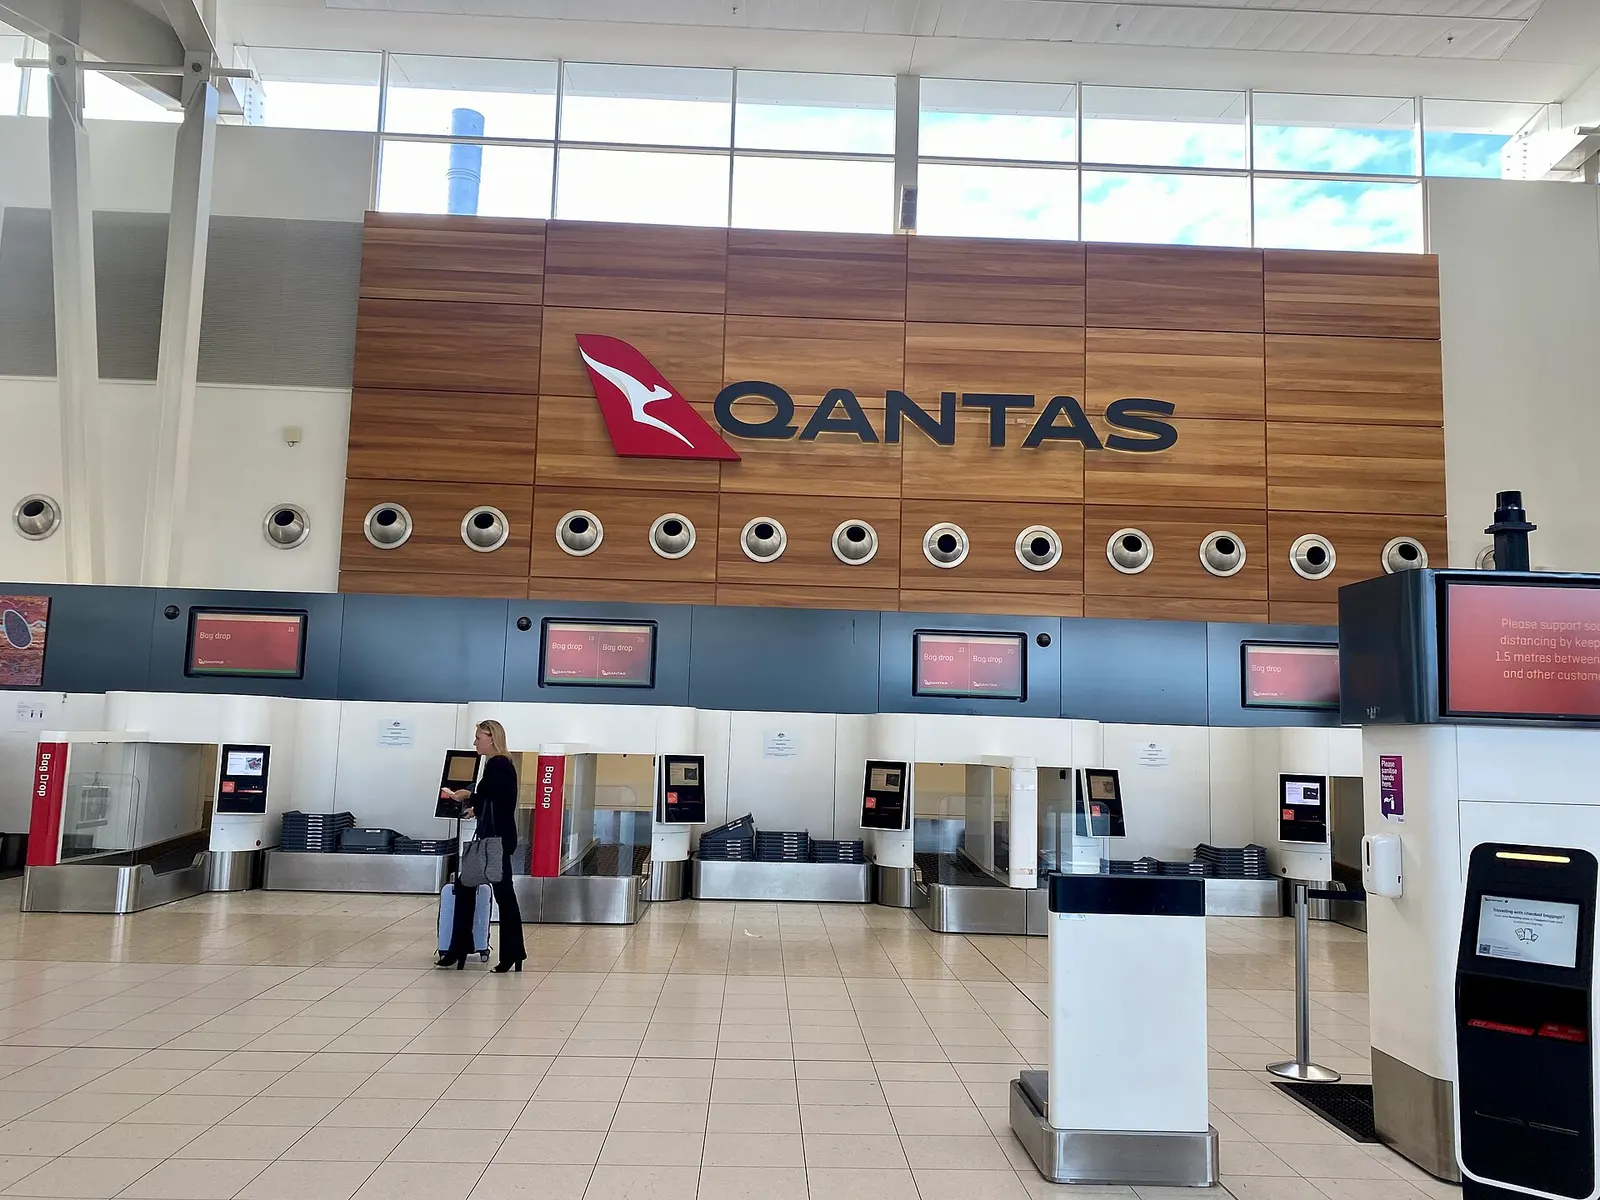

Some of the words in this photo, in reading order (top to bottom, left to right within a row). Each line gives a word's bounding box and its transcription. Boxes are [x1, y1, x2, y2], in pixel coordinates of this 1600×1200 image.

[713, 380, 1179, 454] QANTAS
[1501, 618, 1537, 629] Please
[1540, 621, 1581, 632] support
[200, 631, 214, 640] Bag
[215, 631, 231, 640] drop
[1500, 635, 1557, 648] distancing
[1560, 637, 1572, 648] by
[552, 642, 566, 651] Bag
[567, 642, 583, 651] drop
[602, 643, 616, 652] Bag
[617, 644, 633, 652] drop
[924, 653, 937, 662] Bag
[938, 653, 954, 662] drop
[973, 655, 987, 663] Bag
[987, 655, 1003, 663] drop
[1495, 651, 1511, 662] 1.5
[1513, 653, 1552, 663] metres
[1554, 653, 1600, 664] between
[1251, 665, 1265, 673] Bag
[1267, 665, 1282, 673] drop
[1503, 669, 1524, 679] and
[1526, 669, 1555, 680] other
[39, 753, 51, 772] Bag
[1381, 760, 1395, 768] Please
[542, 766, 554, 784] Bag
[37, 774, 49, 797] Drop
[541, 786, 553, 809] Drop
